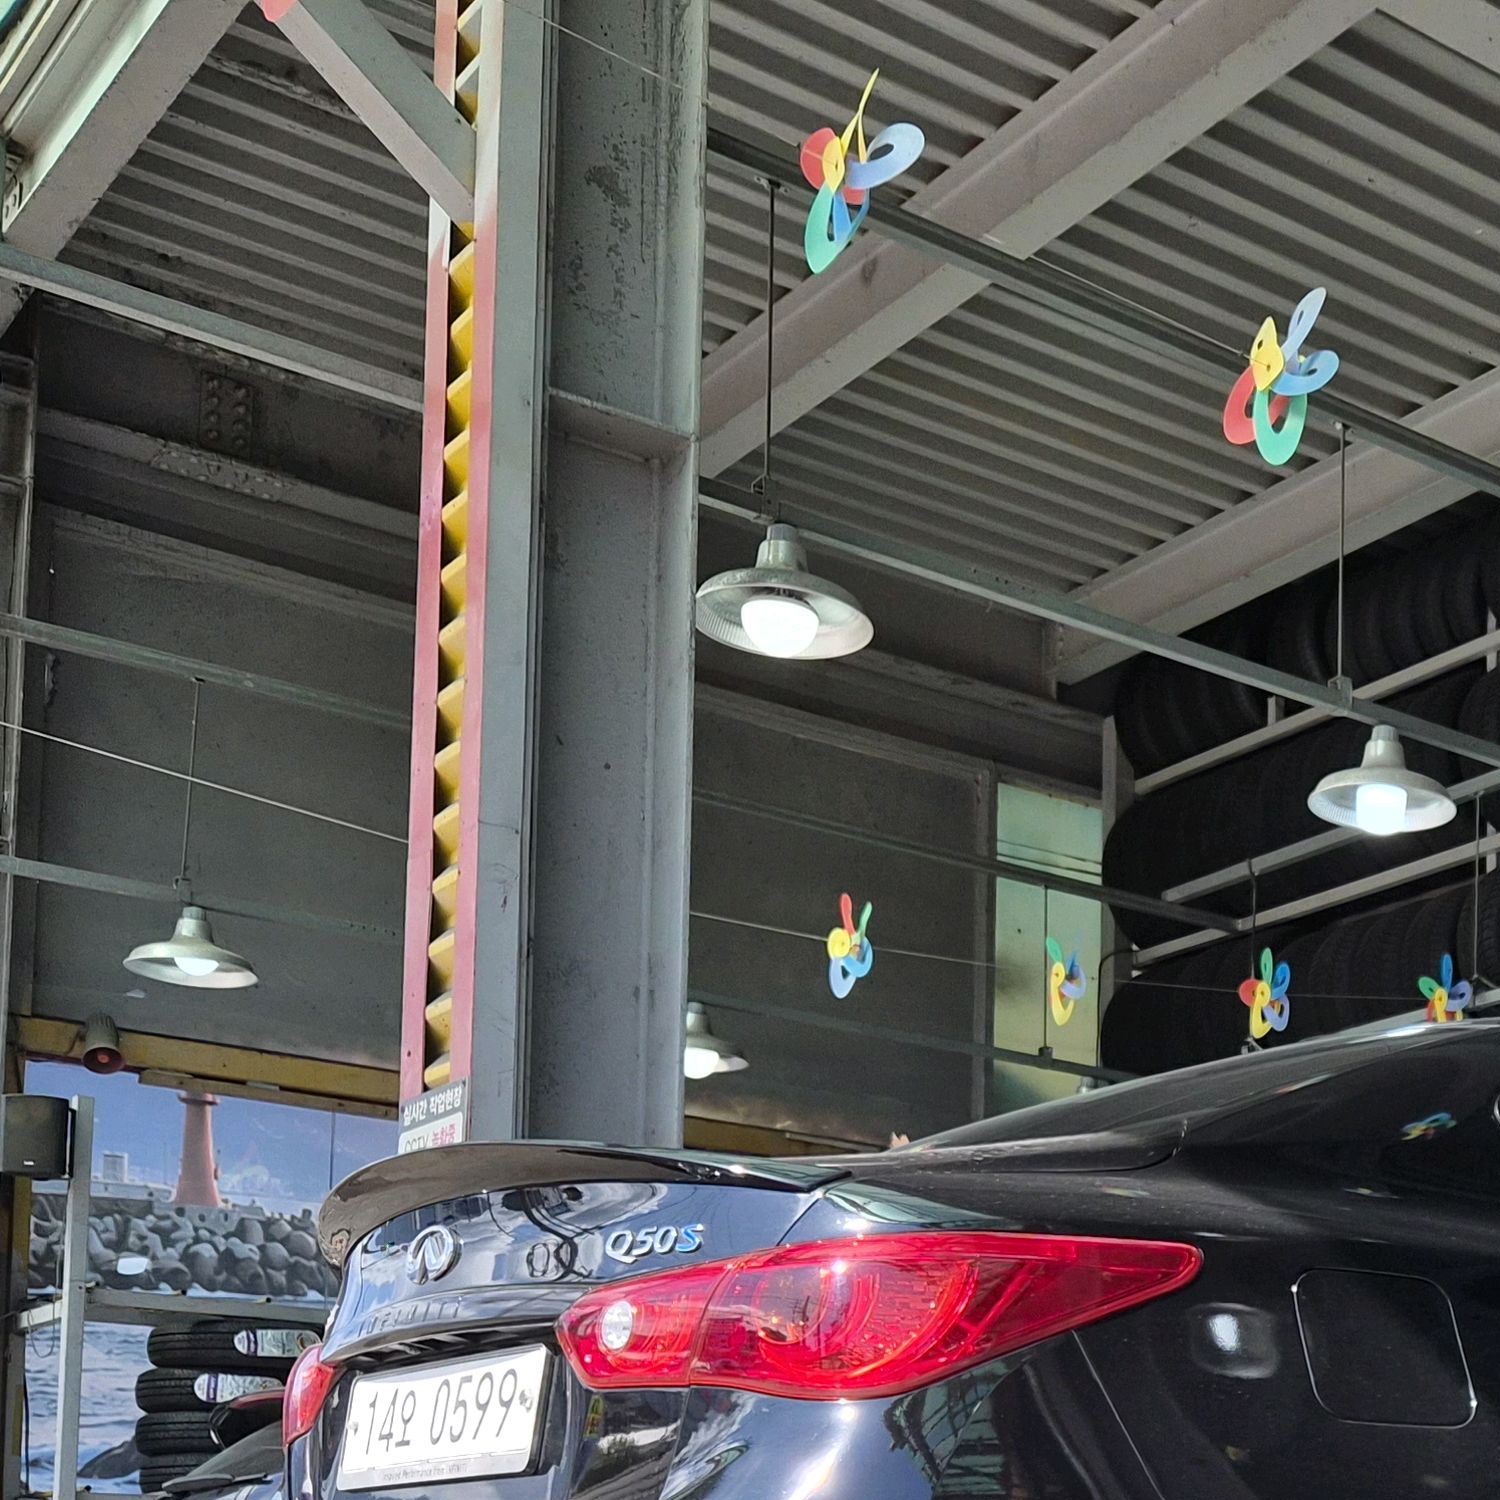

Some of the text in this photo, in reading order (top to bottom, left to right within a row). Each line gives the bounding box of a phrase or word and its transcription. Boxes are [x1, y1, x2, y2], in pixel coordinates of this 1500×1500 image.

[403, 1086, 462, 1126] 실시간 작업현장
[605, 1223, 705, 1264] Q50S
[366, 1368, 518, 1455] 14오 0599
